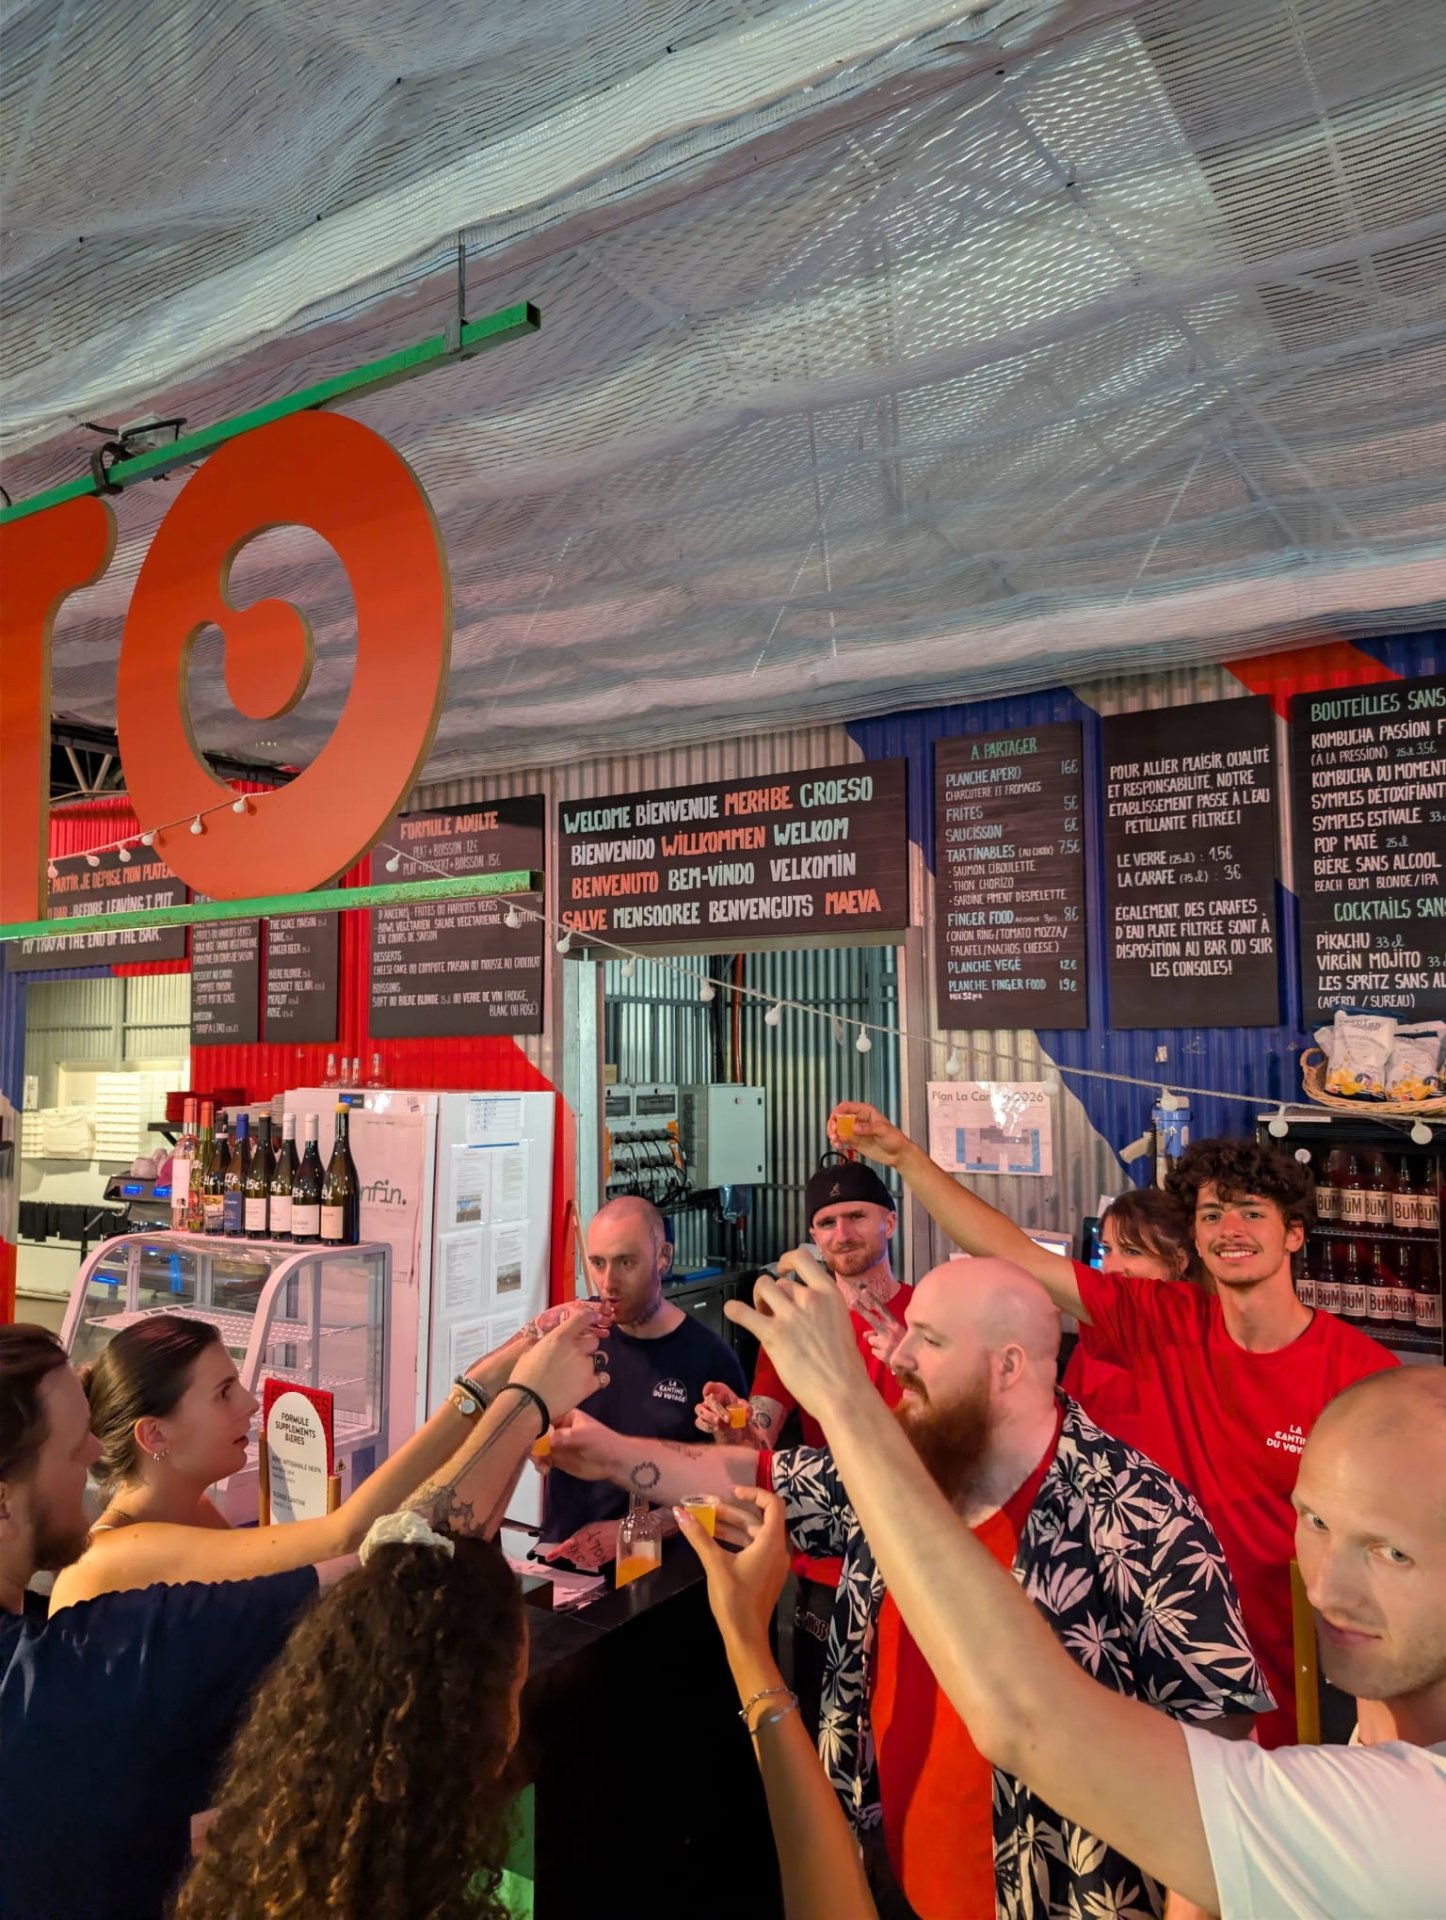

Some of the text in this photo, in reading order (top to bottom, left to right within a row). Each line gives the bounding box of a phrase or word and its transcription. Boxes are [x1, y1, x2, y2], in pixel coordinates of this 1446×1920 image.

[1311, 688, 1445, 722] BOUTEILLES SANS
[1312, 720, 1430, 749] KOMBUCHA PASSION
[984, 737, 1037, 759] PARTAGER
[1110, 745, 1270, 780] POUR ALLIER QUALITÉ
[1326, 752, 1336, 765] LA
[946, 770, 988, 787] PLANCHE
[1312, 759, 1446, 788] KOMBUCHA DU MOMENT
[946, 782, 1041, 801] CHARCUTERIE ET FROMAGES
[1108, 770, 1255, 798] ET NOTRE
[564, 776, 872, 834] WELCOME BIENVENUE MERHBE CROESO
[1109, 792, 1228, 817] ÉTABLISSEMENT PASSE
[1312, 791, 1364, 810] SYMPLES
[946, 806, 983, 822] FRITES
[1312, 807, 1422, 831] SYMPLES ESTIVALE
[401, 811, 498, 840] FORMULE ADULTE
[946, 825, 1002, 842] SAUCISSON
[434, 840, 462, 857] BOISSON
[571, 817, 849, 866] BIENVENIDO WILLKOMMEN WELKOM
[1314, 830, 1378, 853] POP MATÉ
[455, 855, 484, 870] BOISSON
[947, 845, 1015, 863] TARTINABLES
[1117, 851, 1167, 868] LE VERRE
[953, 860, 1036, 877] SAUMON CIBOULETTE
[1314, 852, 1442, 875] BIÈRE SANS ALCOOL
[123, 866, 140, 884] MON
[572, 850, 856, 899] BENVENUTO BEM-VINDO VELKOMIN
[1118, 872, 1132, 887] LA
[1135, 870, 1175, 885] CARAFE
[954, 877, 1014, 891] THON CHORIZO
[1315, 878, 1369, 892] BEACH BUM
[954, 892, 1013, 906] SARDINE PIMENT
[1185, 899, 1257, 917] DES CARAFES
[562, 889, 881, 932] SALVE MENSOOREE BENVENGUTS MAEVA
[948, 910, 985, 926] FINGER
[989, 910, 1013, 925] FOOD
[1334, 897, 1411, 921] COCKTAILS
[1148, 923, 1177, 938] PLATE
[1181, 918, 1224, 936] FILTRÉE
[1229, 919, 1257, 934] SONT
[88, 935, 105, 949] END
[120, 931, 136, 945] THE
[1116, 938, 1273, 959] DISPOSITION AU BAR OU SUR
[1317, 931, 1370, 950] PIKACHU
[948, 960, 992, 974] PLANCHE
[1317, 948, 1420, 971] VIRGIN MOJITO
[1151, 962, 1170, 977] LES
[949, 980, 989, 992] PLANCHE
[992, 979, 1023, 990] FINGER
[1026, 979, 1046, 990] FOOD
[1319, 972, 1428, 991] LES SPRITZ SANS
[933, 1091, 952, 1100] Plan
[956, 1092, 967, 1100] La
[281, 1412, 309, 1427] FORMULE
[275, 1421, 316, 1439] SUPPLEMENTS
[1275, 1431, 1306, 1444] CANTI
[1290, 1425, 1302, 1434] LA
[1266, 1438, 1280, 1448] DU
